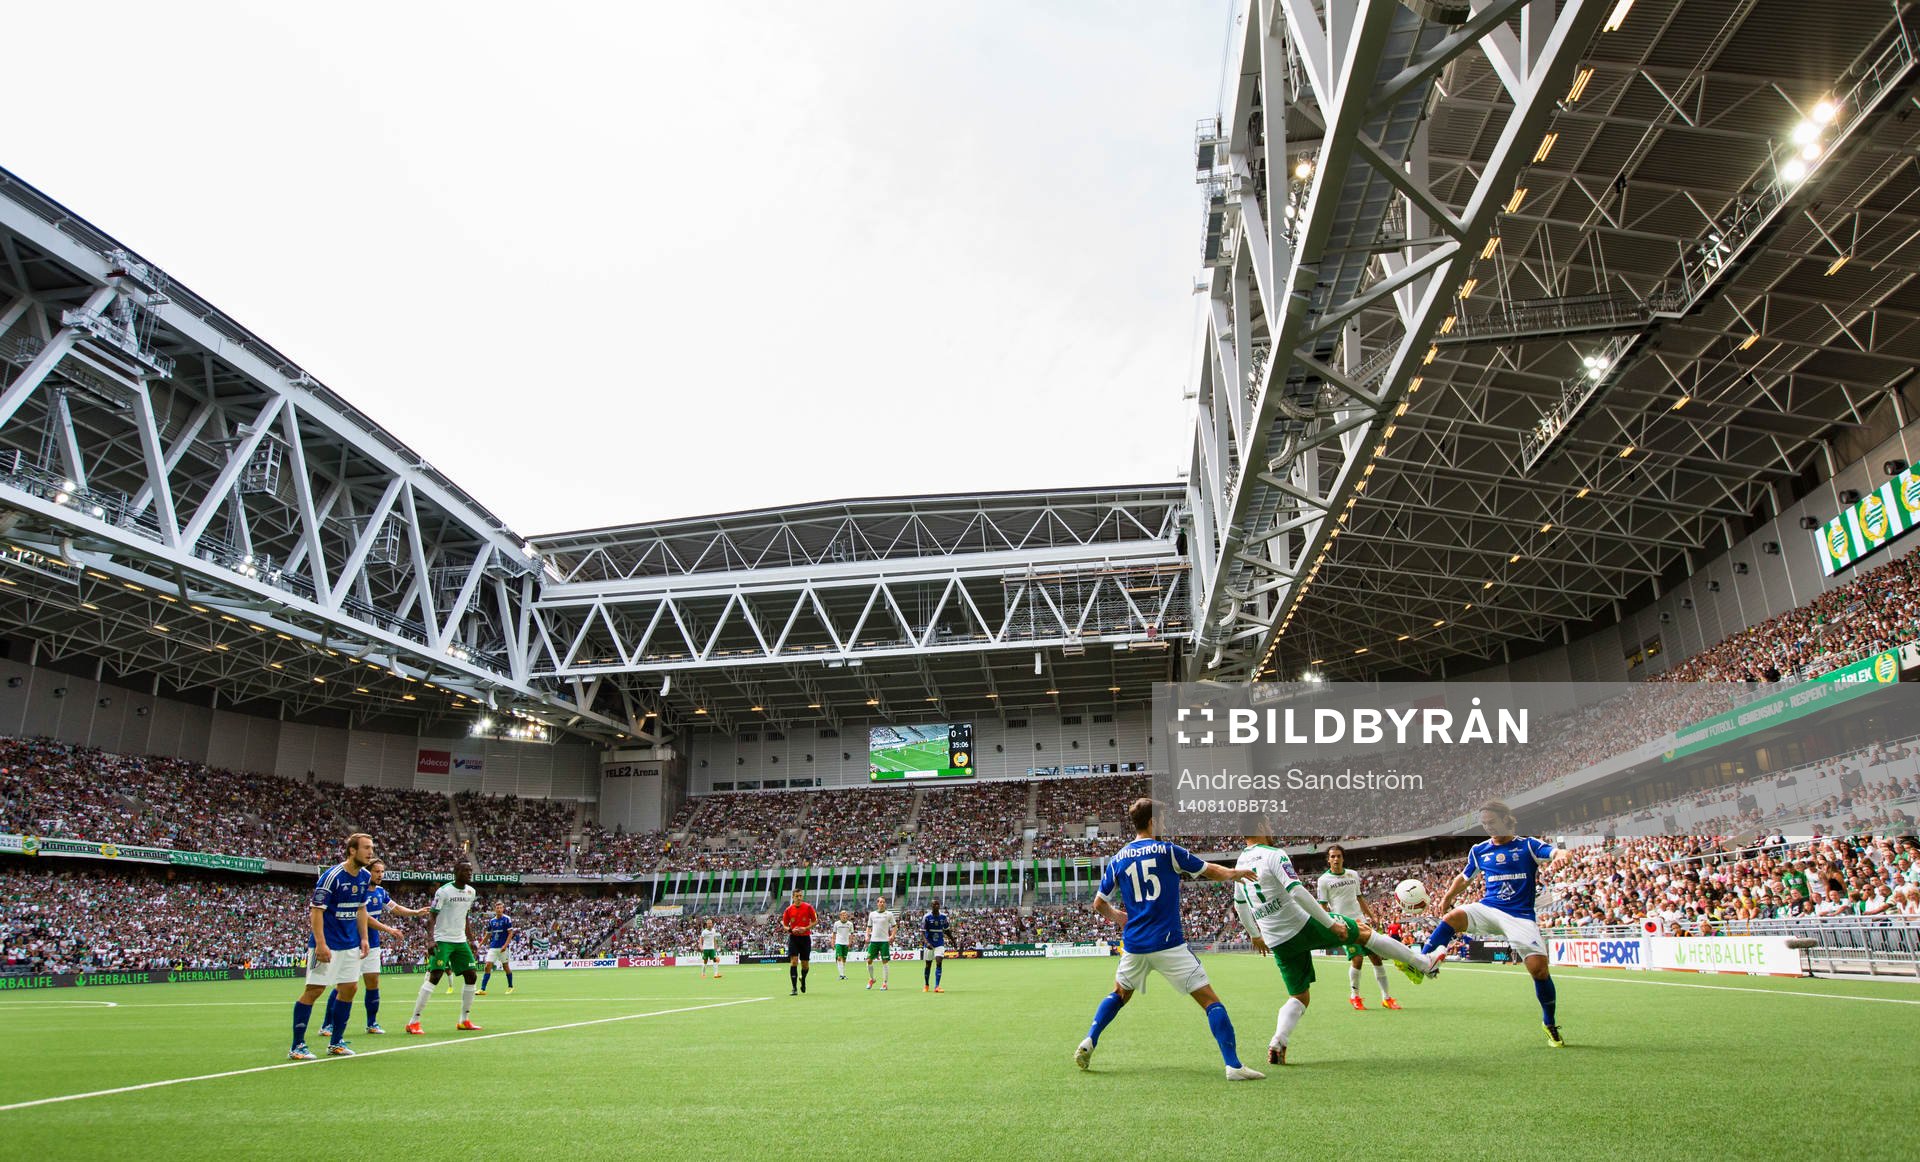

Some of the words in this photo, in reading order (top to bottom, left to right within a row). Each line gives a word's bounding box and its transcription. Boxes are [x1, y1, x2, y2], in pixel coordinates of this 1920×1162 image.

[1790, 683, 1828, 708] RESPEKT
[1833, 667, 1874, 692] KÄRLEK
[420, 758, 449, 767] Adecco
[605, 766, 632, 778] TELE2
[633, 769, 659, 777] Arena
[41, 841, 101, 854] Hammarby
[1115, 843, 1167, 862] LUNDSTRÖM
[402, 871, 432, 880] CURVA
[485, 874, 519, 882] ULTRAS
[1125, 858, 1161, 903] 15
[1009, 949, 1046, 957] JÄGAREN
[1565, 940, 1641, 965] INTERSPORT
[1688, 942, 1766, 965] HERBALIFE
[572, 960, 616, 968] INTERSPORT
[628, 958, 664, 967] Scandic
[89, 973, 149, 985] HERBALIFE
[178, 970, 229, 981] HERBALIFE
[253, 968, 296, 979] HERBALIFE
